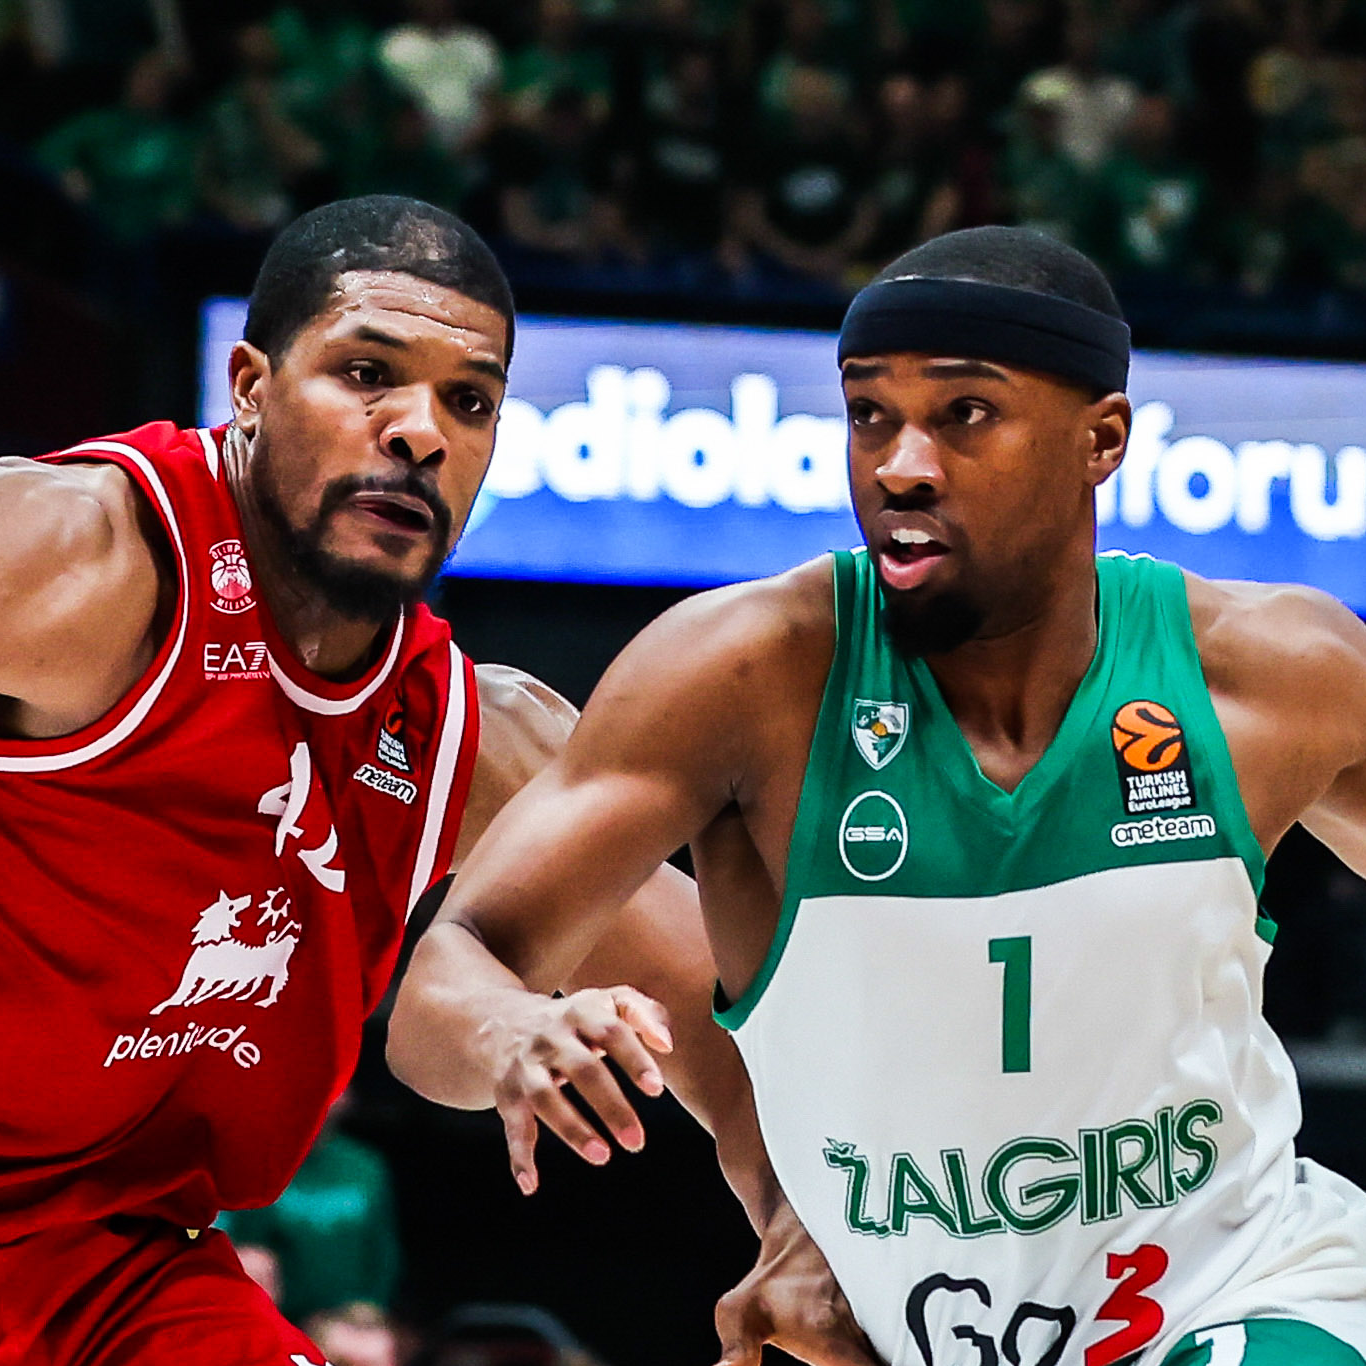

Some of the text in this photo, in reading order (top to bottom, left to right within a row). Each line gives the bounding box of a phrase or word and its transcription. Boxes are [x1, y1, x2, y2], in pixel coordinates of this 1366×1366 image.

[203, 641, 267, 672] EA7
[353, 763, 418, 805] neteam
[1126, 769, 1188, 790] TURKISH
[1128, 781, 1190, 801] AIRLINES
[844, 826, 903, 843] GSA
[1113, 816, 1214, 845] oneteam
[988, 935, 1033, 1073] 1
